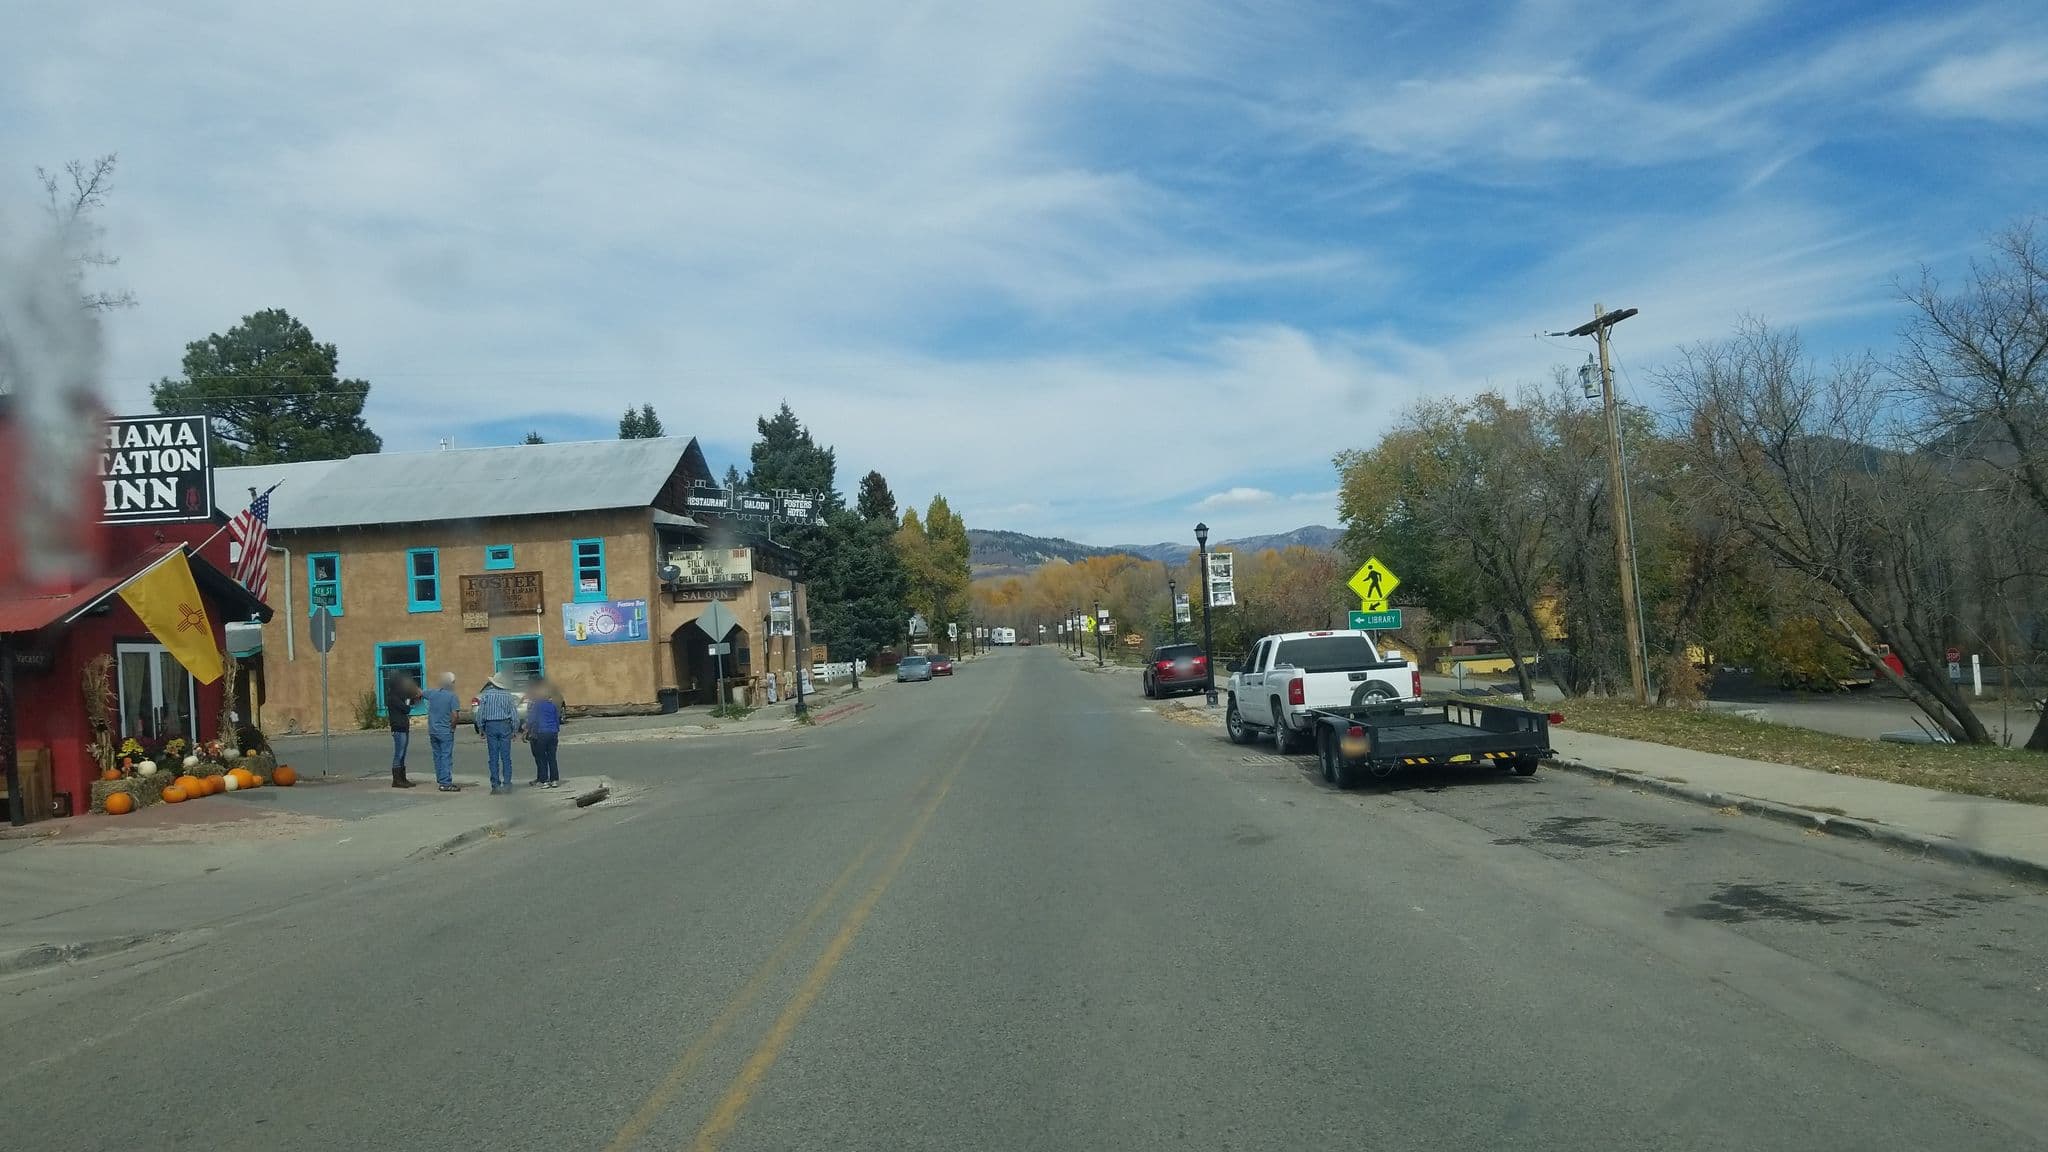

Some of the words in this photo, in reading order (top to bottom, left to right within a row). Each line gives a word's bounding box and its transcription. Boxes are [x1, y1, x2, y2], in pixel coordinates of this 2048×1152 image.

[104, 422, 198, 449] HAMA
[97, 447, 202, 476] TATION
[102, 477, 178, 511] INN
[687, 497, 728, 508] RESTAURANT
[743, 500, 770, 510] SALOON
[787, 507, 808, 518] HOTEL
[468, 575, 537, 591] FOSTER
[682, 589, 729, 601] SALOON
[1367, 615, 1396, 625] LIBRARY
